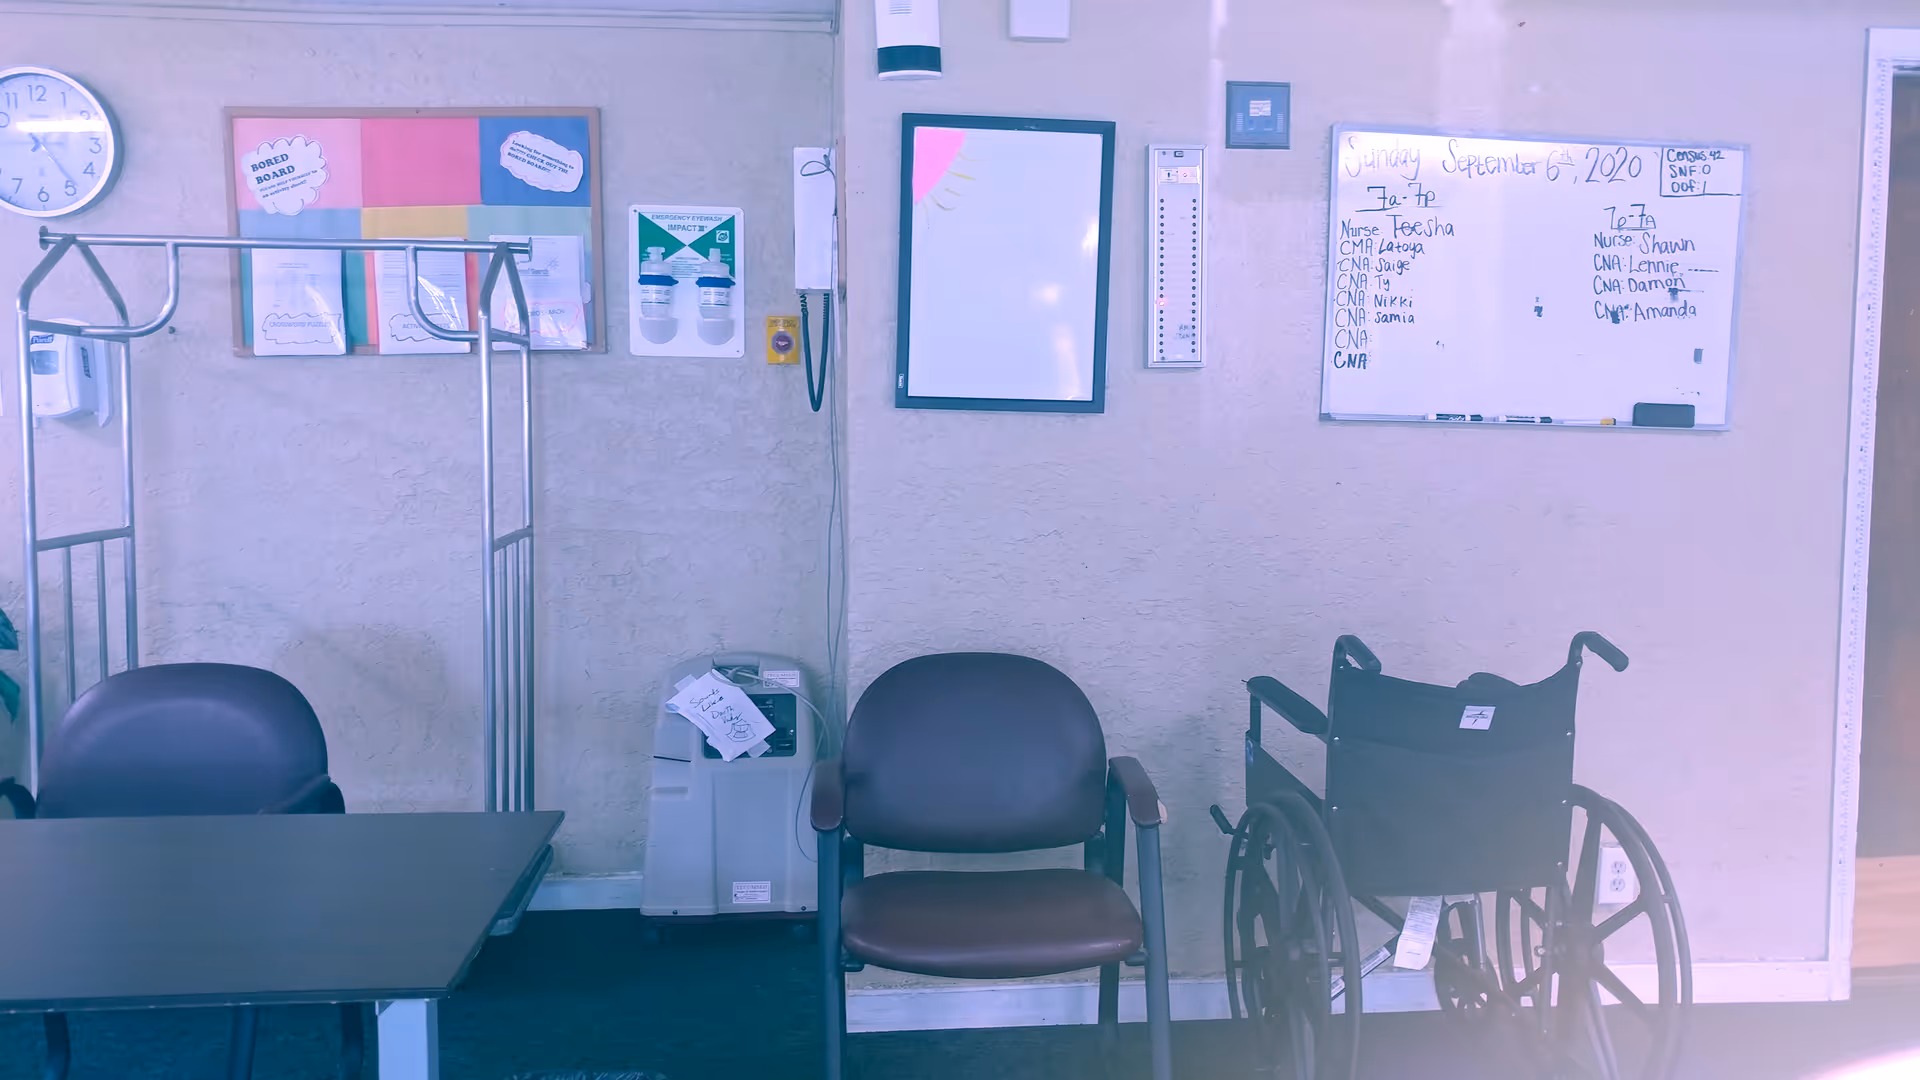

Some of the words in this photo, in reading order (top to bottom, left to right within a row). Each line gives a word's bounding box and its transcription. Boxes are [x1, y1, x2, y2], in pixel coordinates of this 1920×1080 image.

[27, 84, 47, 102] 12
[89, 137, 103, 155] 3
[250, 153, 289, 172] BORED
[507, 151, 527, 163] BORED
[1345, 136, 1420, 181] Sunday
[1442, 138, 1542, 179] September
[1585, 146, 1642, 184] 2020
[82, 162, 96, 177] 4
[255, 165, 295, 184] BOARD
[11, 178, 23, 194] 7
[37, 186, 50, 203] 6
[65, 180, 77, 197] 5
[667, 224, 697, 232] IMPACT
[1379, 238, 1426, 260] Latoya
[1638, 231, 1696, 255] Shawn
[1375, 257, 1411, 276] Saige
[1593, 253, 1627, 273] CNA:
[1628, 254, 1680, 276] Lennie
[1374, 273, 1391, 292] Ty
[1593, 274, 1626, 296] CNA:
[1627, 277, 1687, 293] Damon
[1634, 299, 1697, 322] Amanda
[689, 688, 720, 709] Sounds
